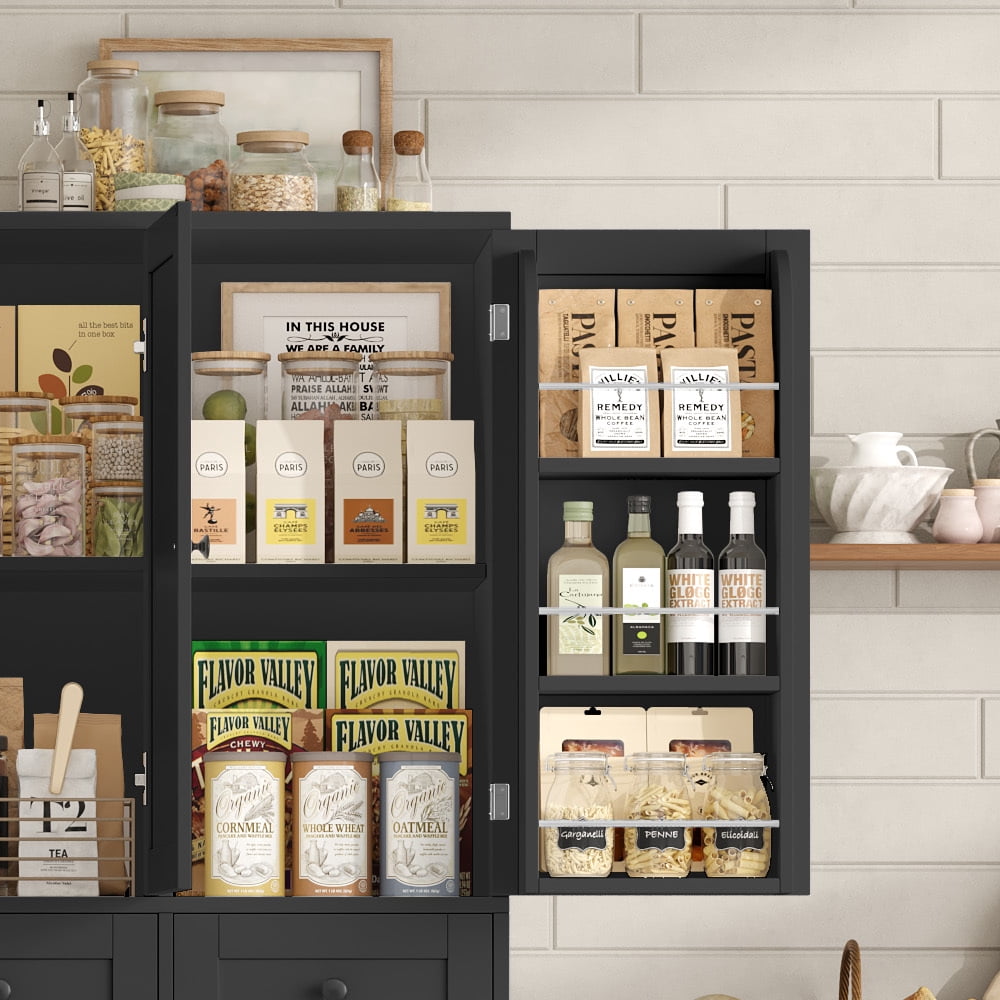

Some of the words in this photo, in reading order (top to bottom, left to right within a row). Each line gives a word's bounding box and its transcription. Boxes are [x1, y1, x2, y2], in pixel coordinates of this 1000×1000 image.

[78, 321, 88, 329] all
[89, 321, 102, 329] the
[103, 321, 119, 329] best
[120, 321, 134, 329] bits
[286, 321, 301, 332] IN
[305, 321, 335, 332] THIS
[339, 321, 385, 332] HOUSE
[78, 330, 87, 338] in
[88, 330, 101, 338] one
[102, 330, 116, 338] box
[286, 344, 304, 353] WE
[307, 344, 329, 353] ARE
[332, 344, 340, 353] A
[343, 344, 385, 353] FAMILY
[291, 384, 322, 393] PRAISE
[597, 403, 643, 411] REMEDY
[678, 403, 724, 411] REMEDY
[200, 463, 224, 472] PARIS
[279, 463, 303, 472] PARIS
[357, 463, 381, 472] PARIS
[430, 463, 454, 472] PARIS
[669, 573, 711, 586] WHITE
[721, 573, 763, 586] WHITE
[669, 599, 711, 609] EXTRACT
[721, 599, 763, 609] EXTRACT
[197, 658, 255, 709] FLAVOR
[260, 658, 315, 709] VALLEY
[339, 658, 397, 709] FLAVOR
[402, 658, 457, 709] VALLEY
[389, 688, 419, 698] GRANOLA
[209, 716, 249, 743] FLAVOR
[253, 716, 290, 742] VALLEY
[335, 719, 399, 752] FLAVOR
[404, 719, 465, 753] VALLEY
[229, 739, 266, 749] CHEWY
[215, 779, 270, 819] Organic
[303, 779, 358, 819] Organic
[391, 779, 446, 819] Organic
[30, 796, 88, 834] T2
[216, 822, 274, 833] CORNMEAL
[302, 823, 332, 833] WHOLE
[334, 823, 365, 833] WHEAT
[392, 821, 449, 833] OATMEAL
[560, 830, 604, 841] Garganelli
[644, 830, 679, 839] PENNE
[48, 848, 69, 859] TEA
